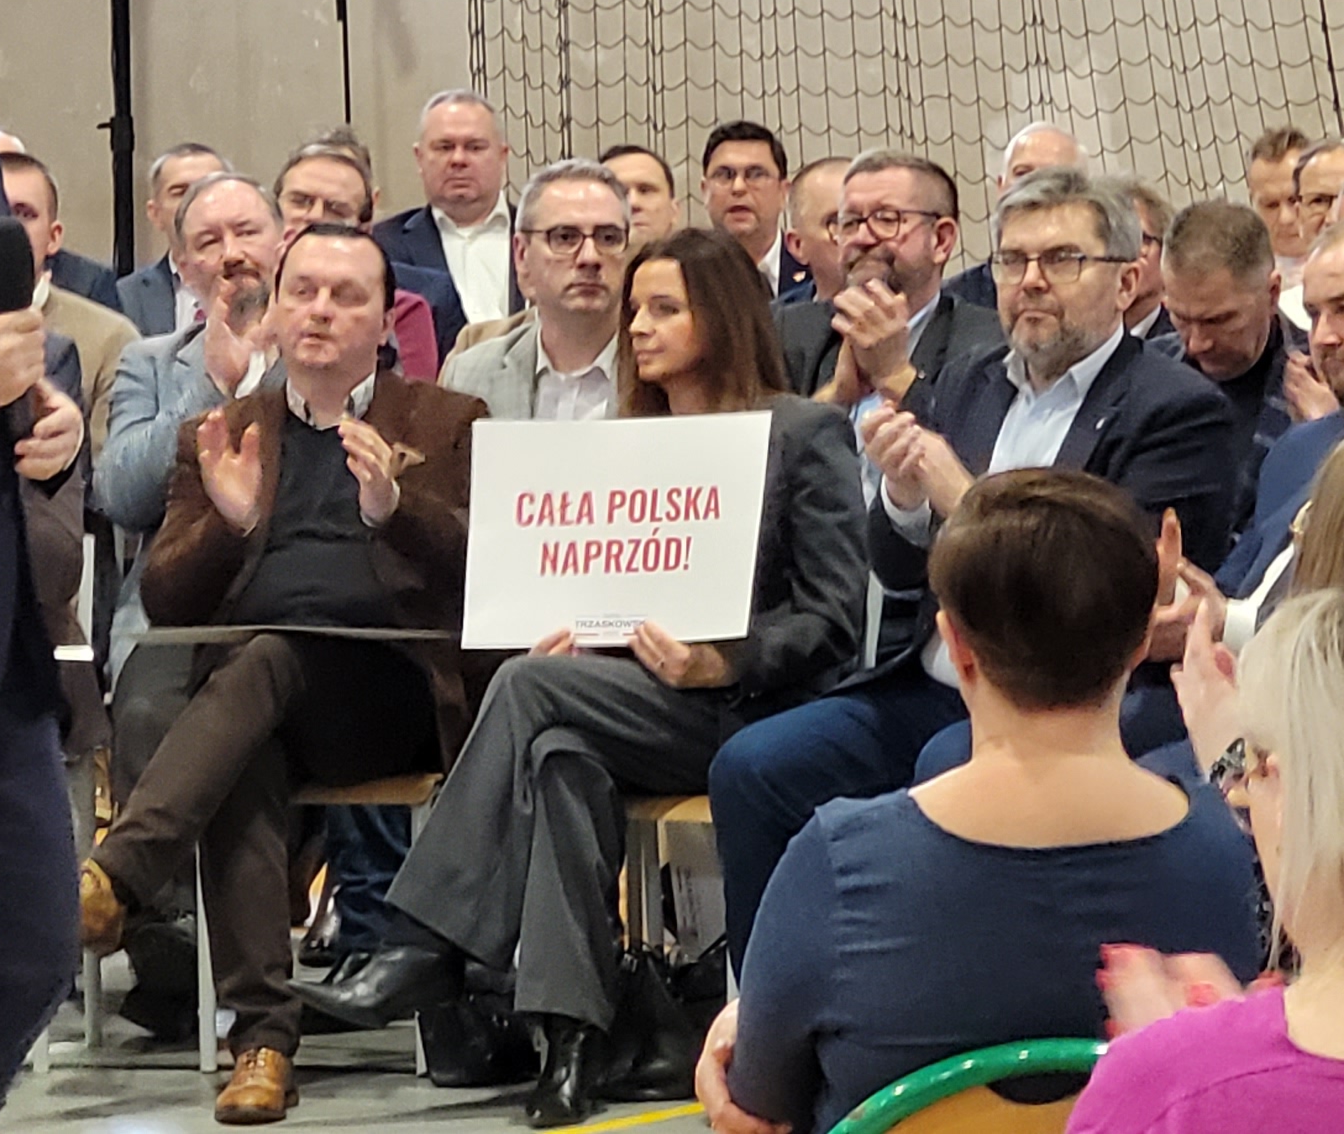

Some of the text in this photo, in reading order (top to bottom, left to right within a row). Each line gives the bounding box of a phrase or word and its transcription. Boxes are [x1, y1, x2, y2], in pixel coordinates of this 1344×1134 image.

[515, 486, 721, 528] CAŁA POLSKA
[539, 528, 692, 577] NAPRZÓD!
[575, 619, 645, 629] TRZASKOWSK
